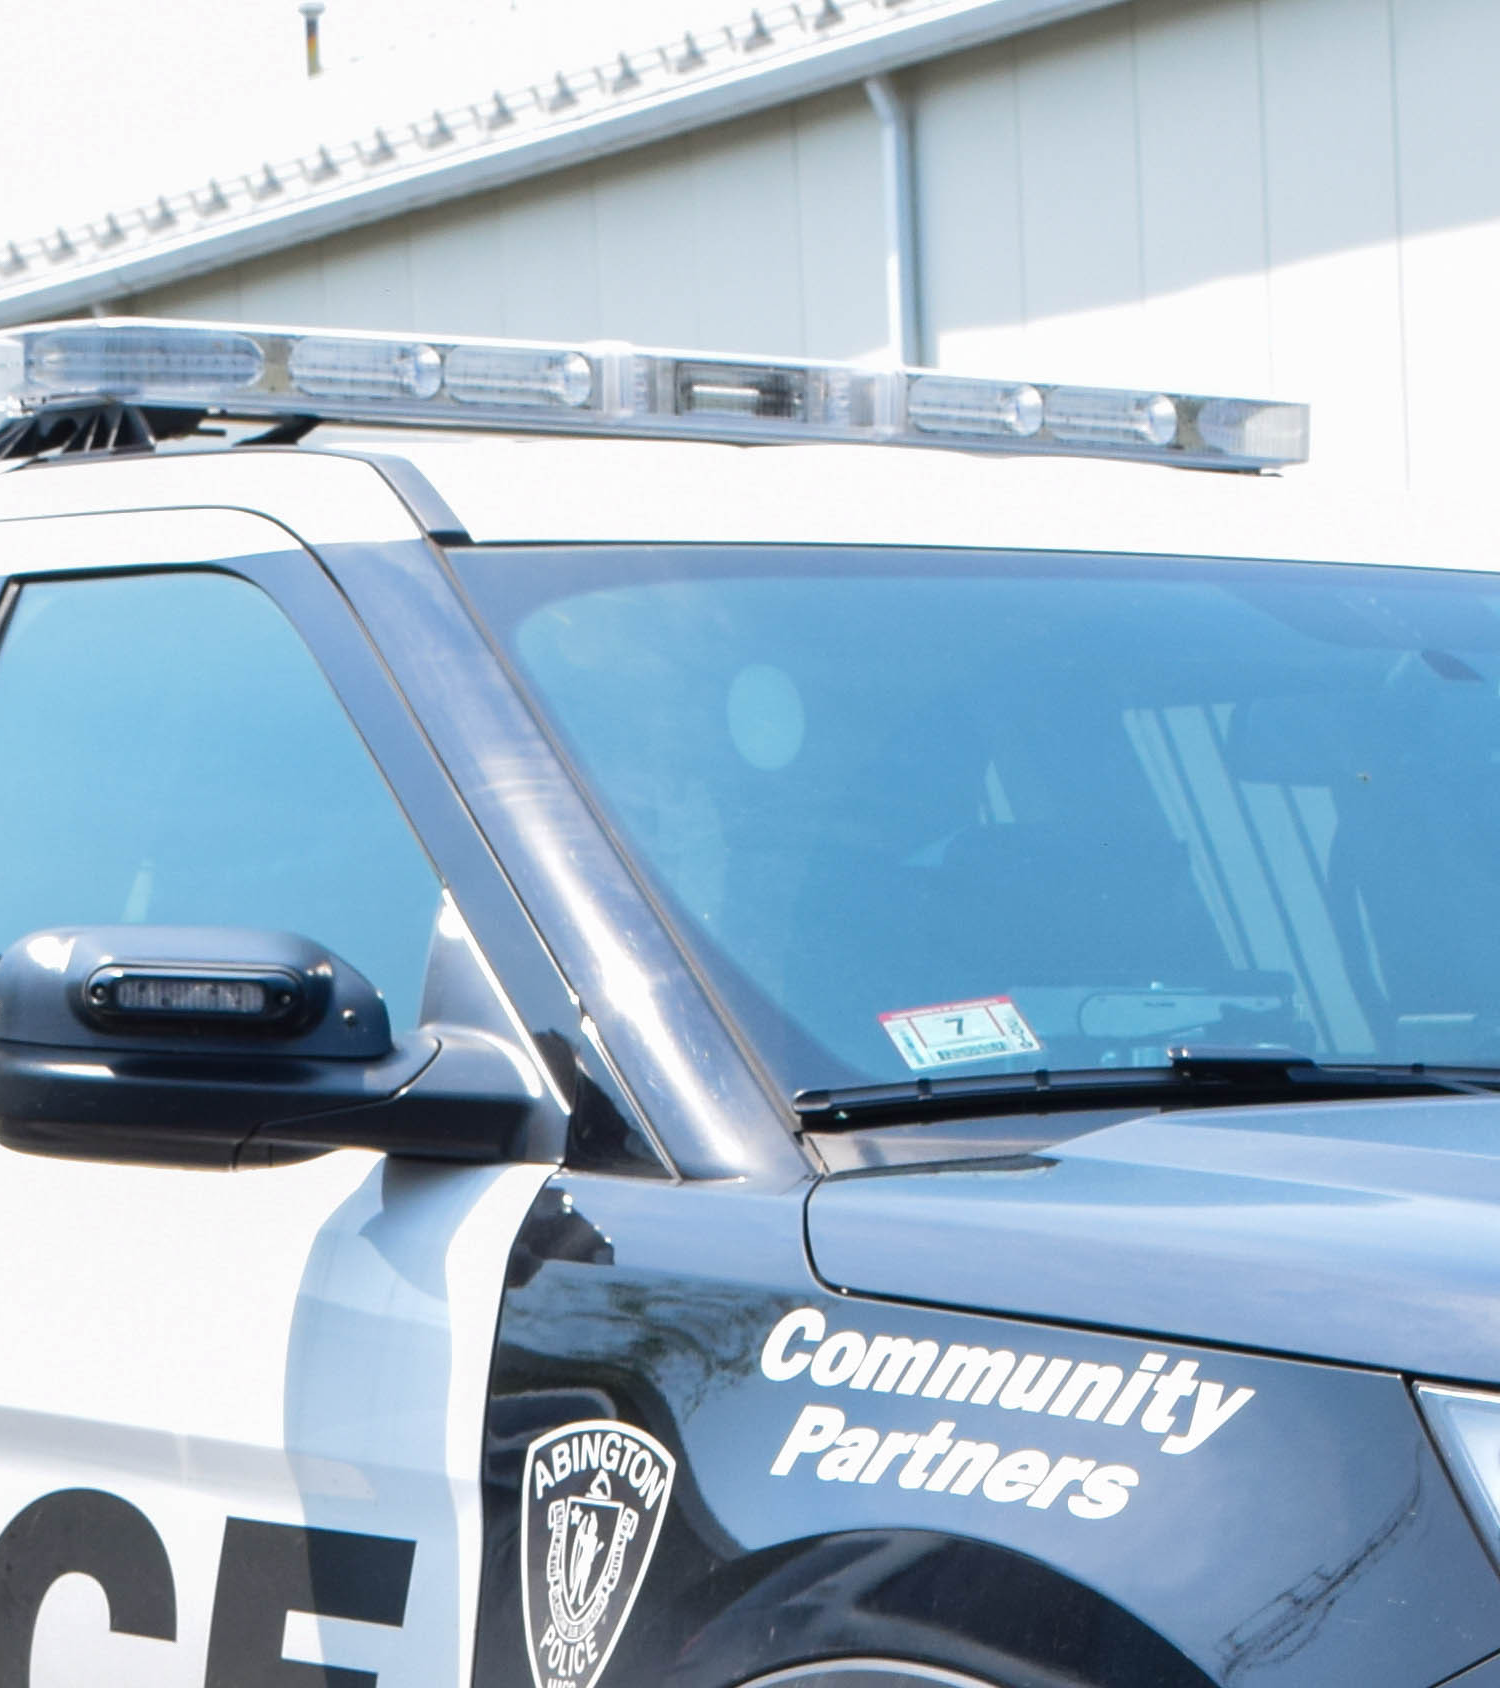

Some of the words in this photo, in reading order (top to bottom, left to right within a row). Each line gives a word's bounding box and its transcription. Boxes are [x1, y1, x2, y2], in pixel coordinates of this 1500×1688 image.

[944, 1016, 964, 1036] 7
[760, 1308, 1256, 1455] Community
[534, 1432, 666, 1510] ABINGTON
[771, 1405, 1140, 1520] Partners
[539, 1624, 599, 1678] POLICE
